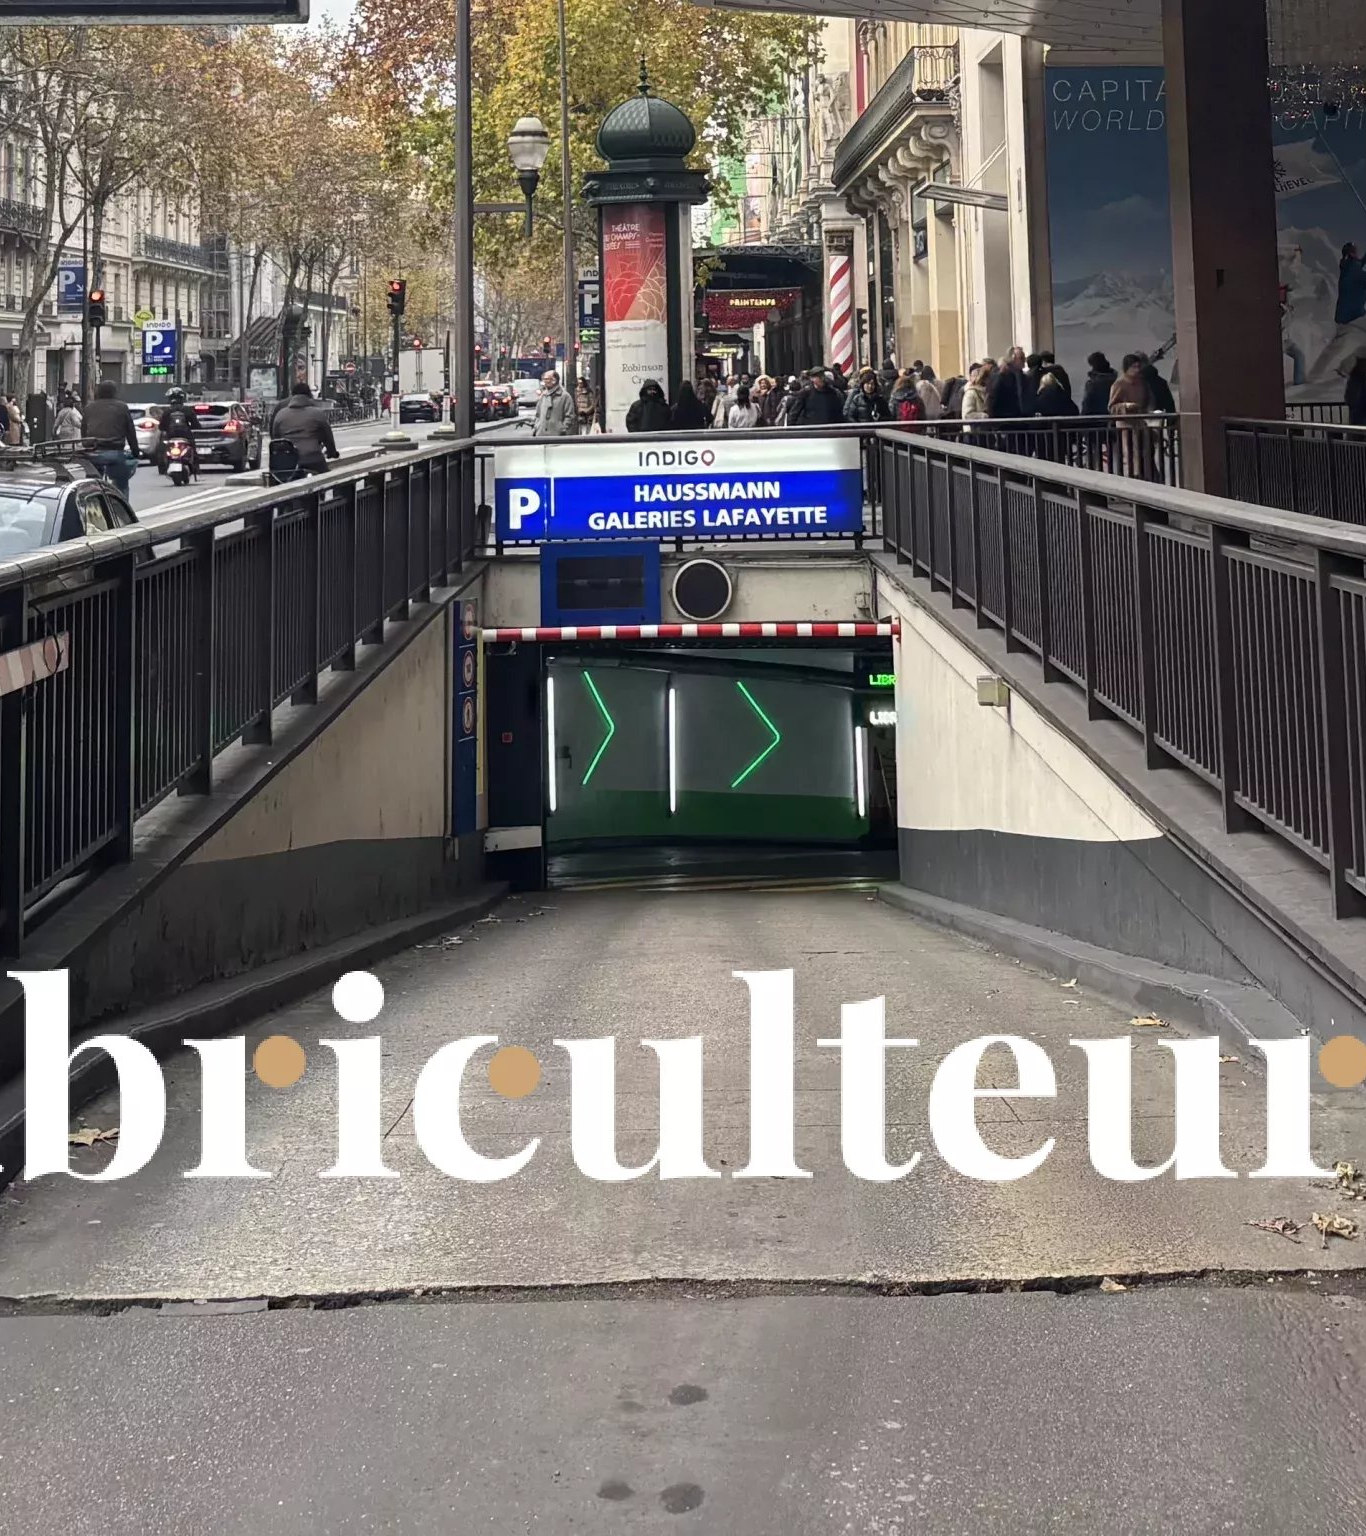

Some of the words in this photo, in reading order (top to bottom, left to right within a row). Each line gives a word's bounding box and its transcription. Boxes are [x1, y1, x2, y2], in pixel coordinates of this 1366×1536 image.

[1053, 109, 1165, 131] WORLD
[59, 270, 75, 292] P
[730, 298, 775, 306] PRINTEMPS
[145, 331, 163, 353] P
[622, 363, 664, 373] Robinson
[638, 449, 715, 467] INDIGO
[634, 481, 780, 502] HAUSSMANN
[509, 488, 540, 529] P
[588, 510, 696, 531] GALERIES
[703, 506, 828, 527] LAFAYETTE
